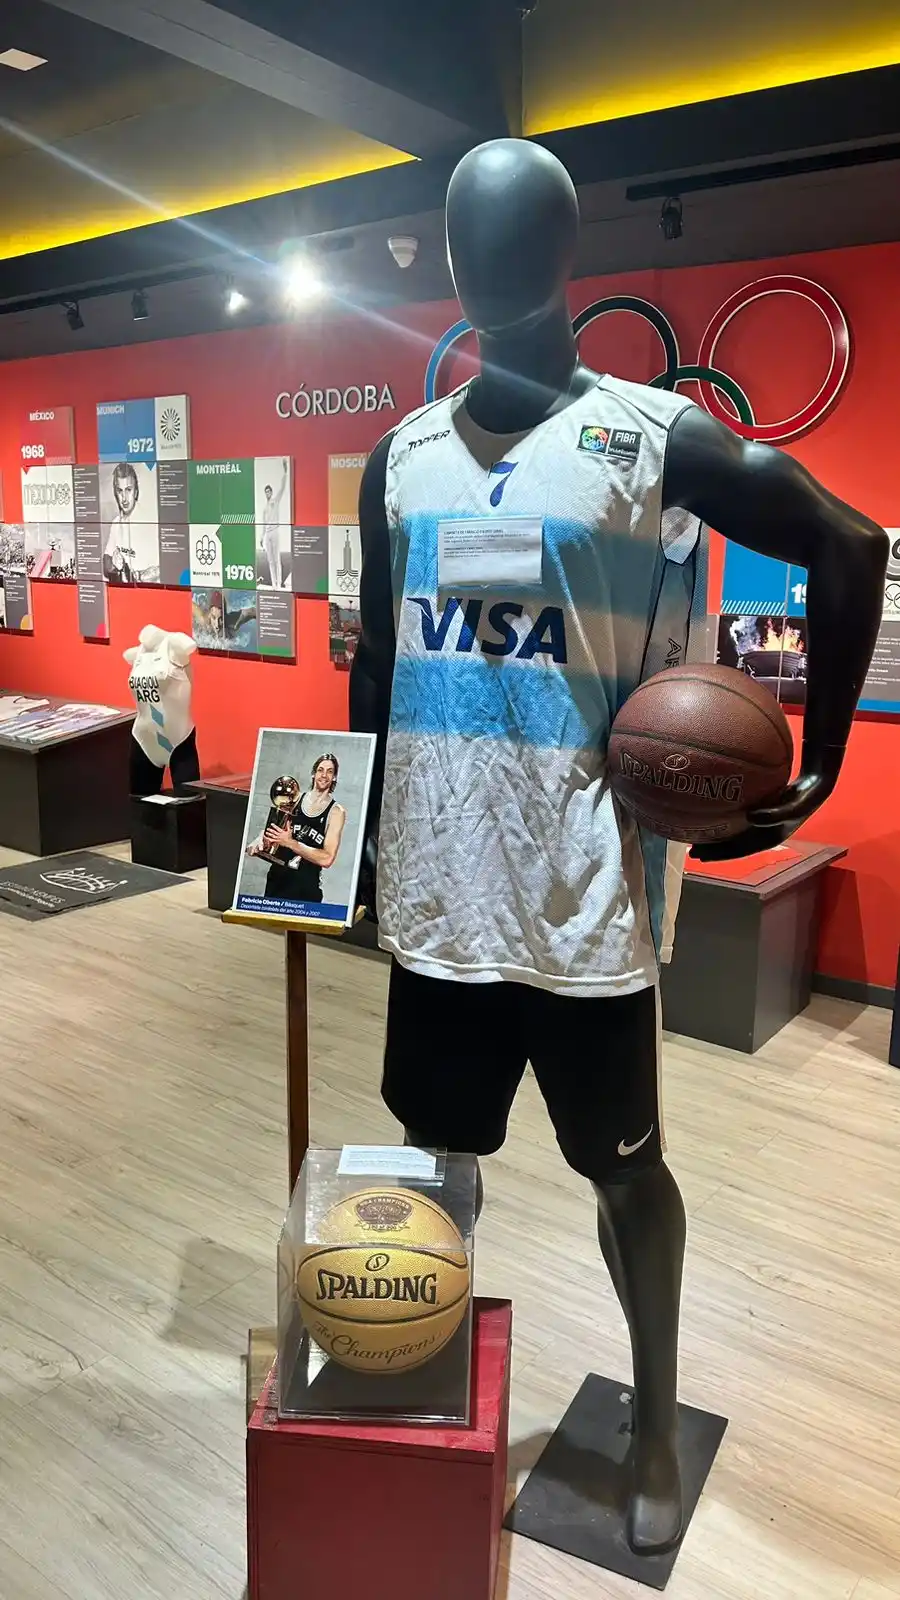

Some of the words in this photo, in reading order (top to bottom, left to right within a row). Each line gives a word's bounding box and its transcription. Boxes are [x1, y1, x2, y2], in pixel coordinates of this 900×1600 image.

[275, 383, 396, 418] CÓRDOBA
[29, 409, 55, 421] MÉXICO
[615, 431, 636, 444] FIBA
[21, 444, 45, 459] 1968
[128, 438, 154, 453] 1972
[196, 462, 242, 475] MONTRÉAL
[487, 461, 519, 508] 7
[224, 565, 254, 581] 1976
[406, 597, 568, 665] VISA
[136, 689, 160, 703] ARG
[620, 750, 743, 802] SPALDING
[315, 1268, 438, 1305] SPALDING
